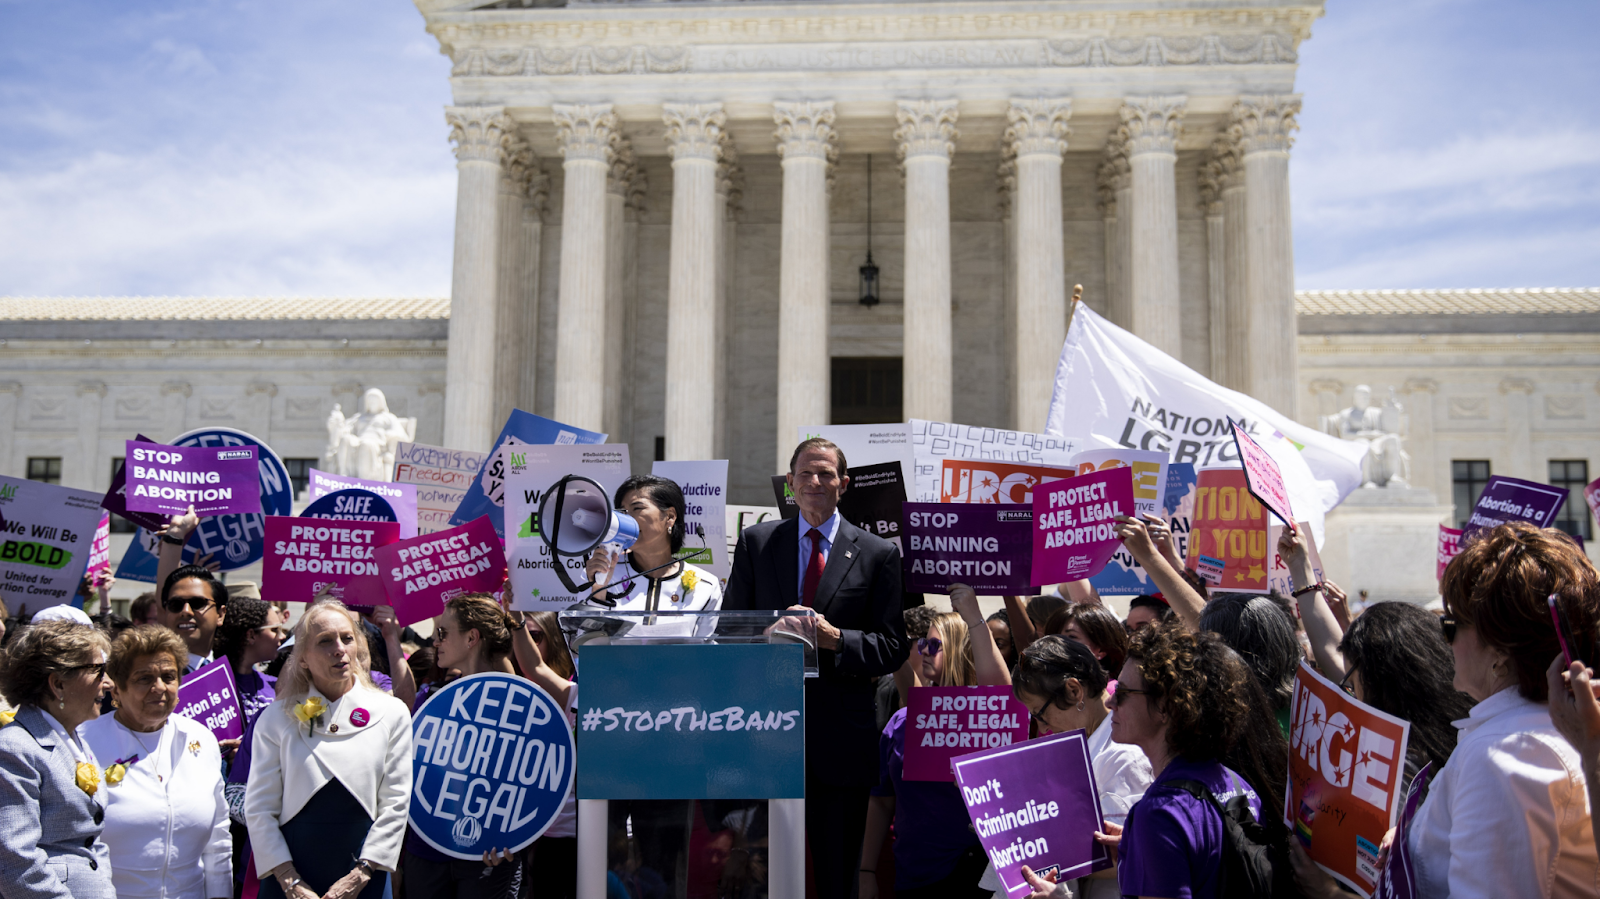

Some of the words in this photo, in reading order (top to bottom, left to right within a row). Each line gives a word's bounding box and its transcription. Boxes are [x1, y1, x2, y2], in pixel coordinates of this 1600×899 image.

[1131, 396, 1260, 436] NATIONAL
[1022, 433, 1074, 452] about
[133, 448, 183, 465] STOP
[133, 466, 221, 484] BANNING
[396, 464, 464, 485] Freedom
[133, 484, 232, 502] ABORTION
[416, 490, 466, 504] norance
[682, 483, 721, 496] ductive
[1049, 481, 1107, 509] PROTECT
[334, 495, 374, 514] SAFE
[684, 502, 703, 515] tice
[1193, 487, 1262, 521] TION
[1477, 496, 1521, 517] Abortion
[1522, 504, 1533, 518] is
[1534, 510, 1545, 521] a
[910, 511, 958, 529] STOP
[1007, 511, 1033, 519] NARAL
[1039, 509, 1077, 531] SAFE,
[1080, 500, 1124, 524] LEGAL
[4, 520, 26, 536] We
[31, 524, 58, 540] Will
[60, 529, 78, 543] Be
[291, 525, 375, 544] PROTECT
[876, 520, 899, 535] Be
[1044, 523, 1118, 550] ABORTION
[1, 540, 64, 566] BOLD
[274, 541, 327, 560] SAFE,
[331, 544, 376, 560] LEGA
[397, 532, 470, 563] PROTECT
[910, 535, 998, 553] BANNING
[1212, 529, 1267, 560] YOU
[280, 557, 380, 576] ABORTION
[391, 557, 440, 582] SAFE,
[439, 541, 493, 567] LEGAL
[911, 559, 1011, 577] ABORTION
[5, 570, 36, 584] United
[40, 574, 54, 585] for
[405, 556, 493, 595] ABORTION
[0, 582, 24, 593] rtion
[26, 585, 67, 599] Coverage
[1097, 585, 1145, 595] prochoice.org
[177, 699, 211, 720] tion
[207, 691, 222, 707] is
[221, 687, 231, 700] a
[449, 680, 551, 735] KEEP
[931, 695, 1010, 711] PROTECT
[205, 705, 237, 731] Right
[915, 713, 963, 731] SAFE,
[968, 713, 1020, 730] LEGAL
[920, 731, 1012, 748] ABORTION
[1290, 676, 1396, 812] URGE
[412, 716, 565, 793] ABORTION
[414, 765, 539, 833] LEGAL
[963, 778, 1003, 807] Don't
[975, 799, 1059, 838] Criminalize
[990, 836, 1049, 870] Abortion
